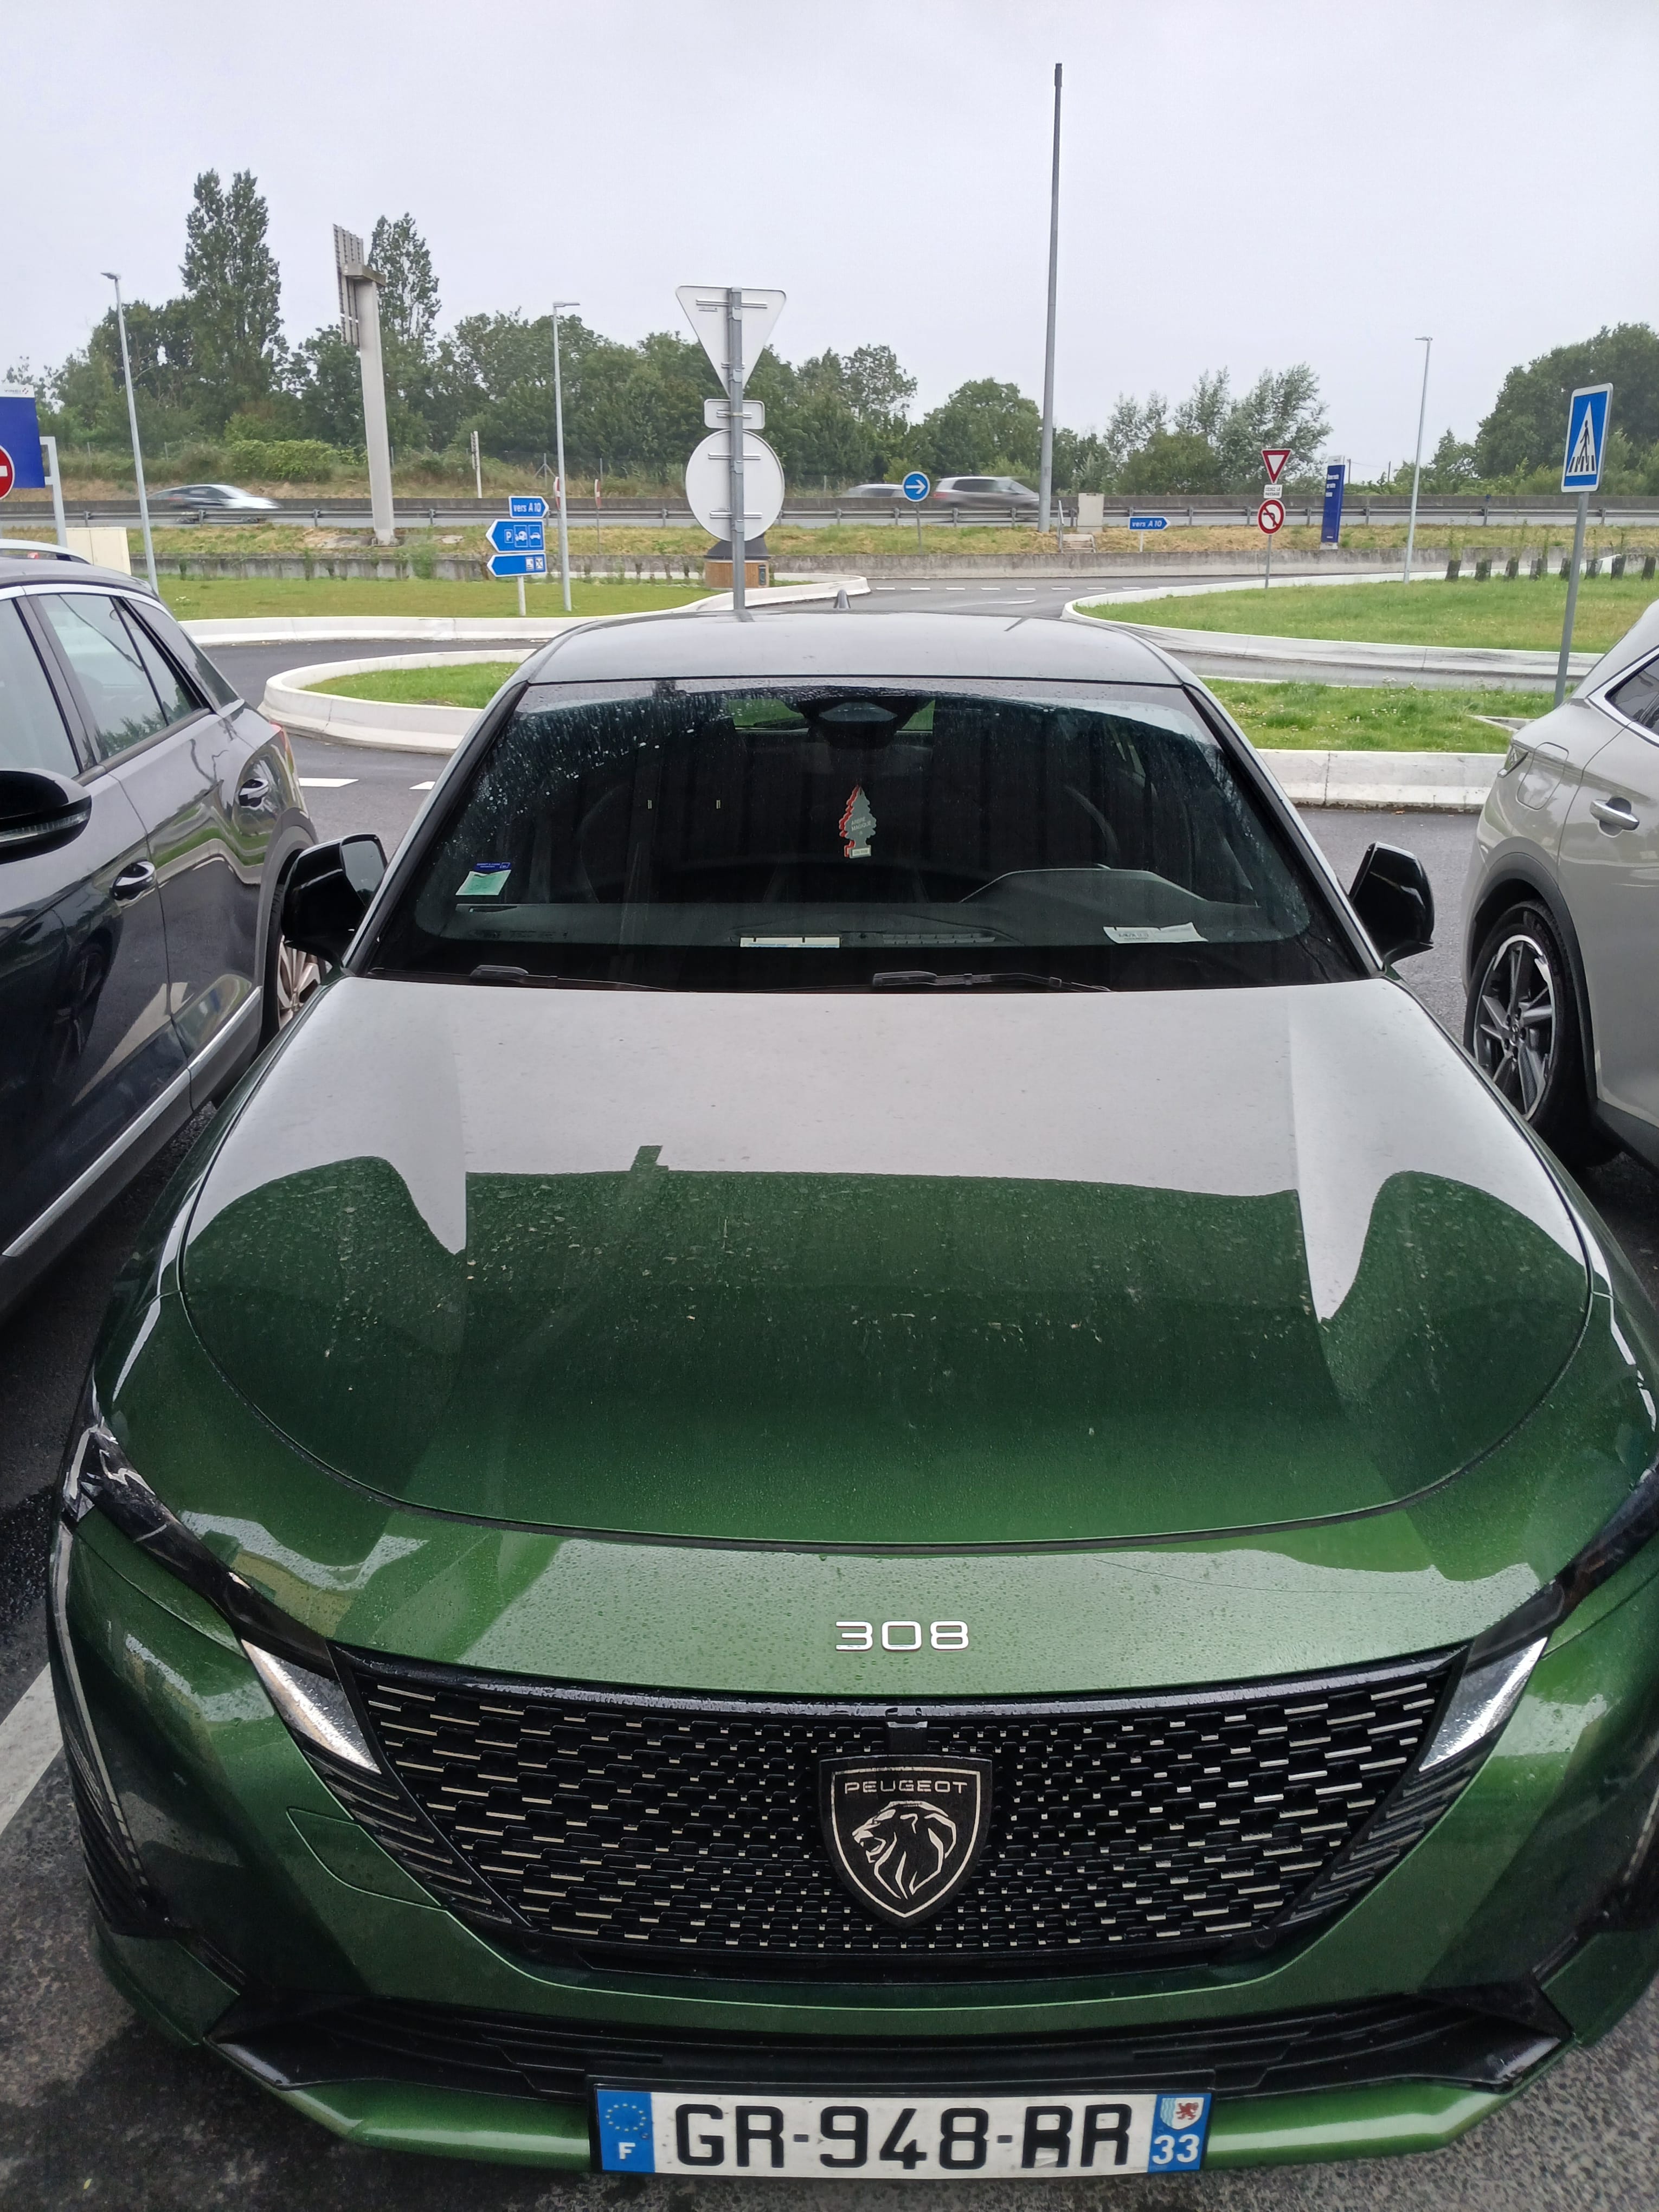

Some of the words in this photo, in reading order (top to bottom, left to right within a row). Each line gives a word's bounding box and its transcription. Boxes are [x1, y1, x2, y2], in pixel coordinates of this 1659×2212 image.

[506, 531, 512, 541] P
[852, 820, 871, 832] MAGIQUE
[836, 1621, 969, 1651] 308
[845, 1780, 968, 1794] PEUGEOT
[619, 2142, 636, 2159] F
[676, 2103, 1132, 2170] GR-948-RR
[1152, 2134, 1200, 2164] 33
